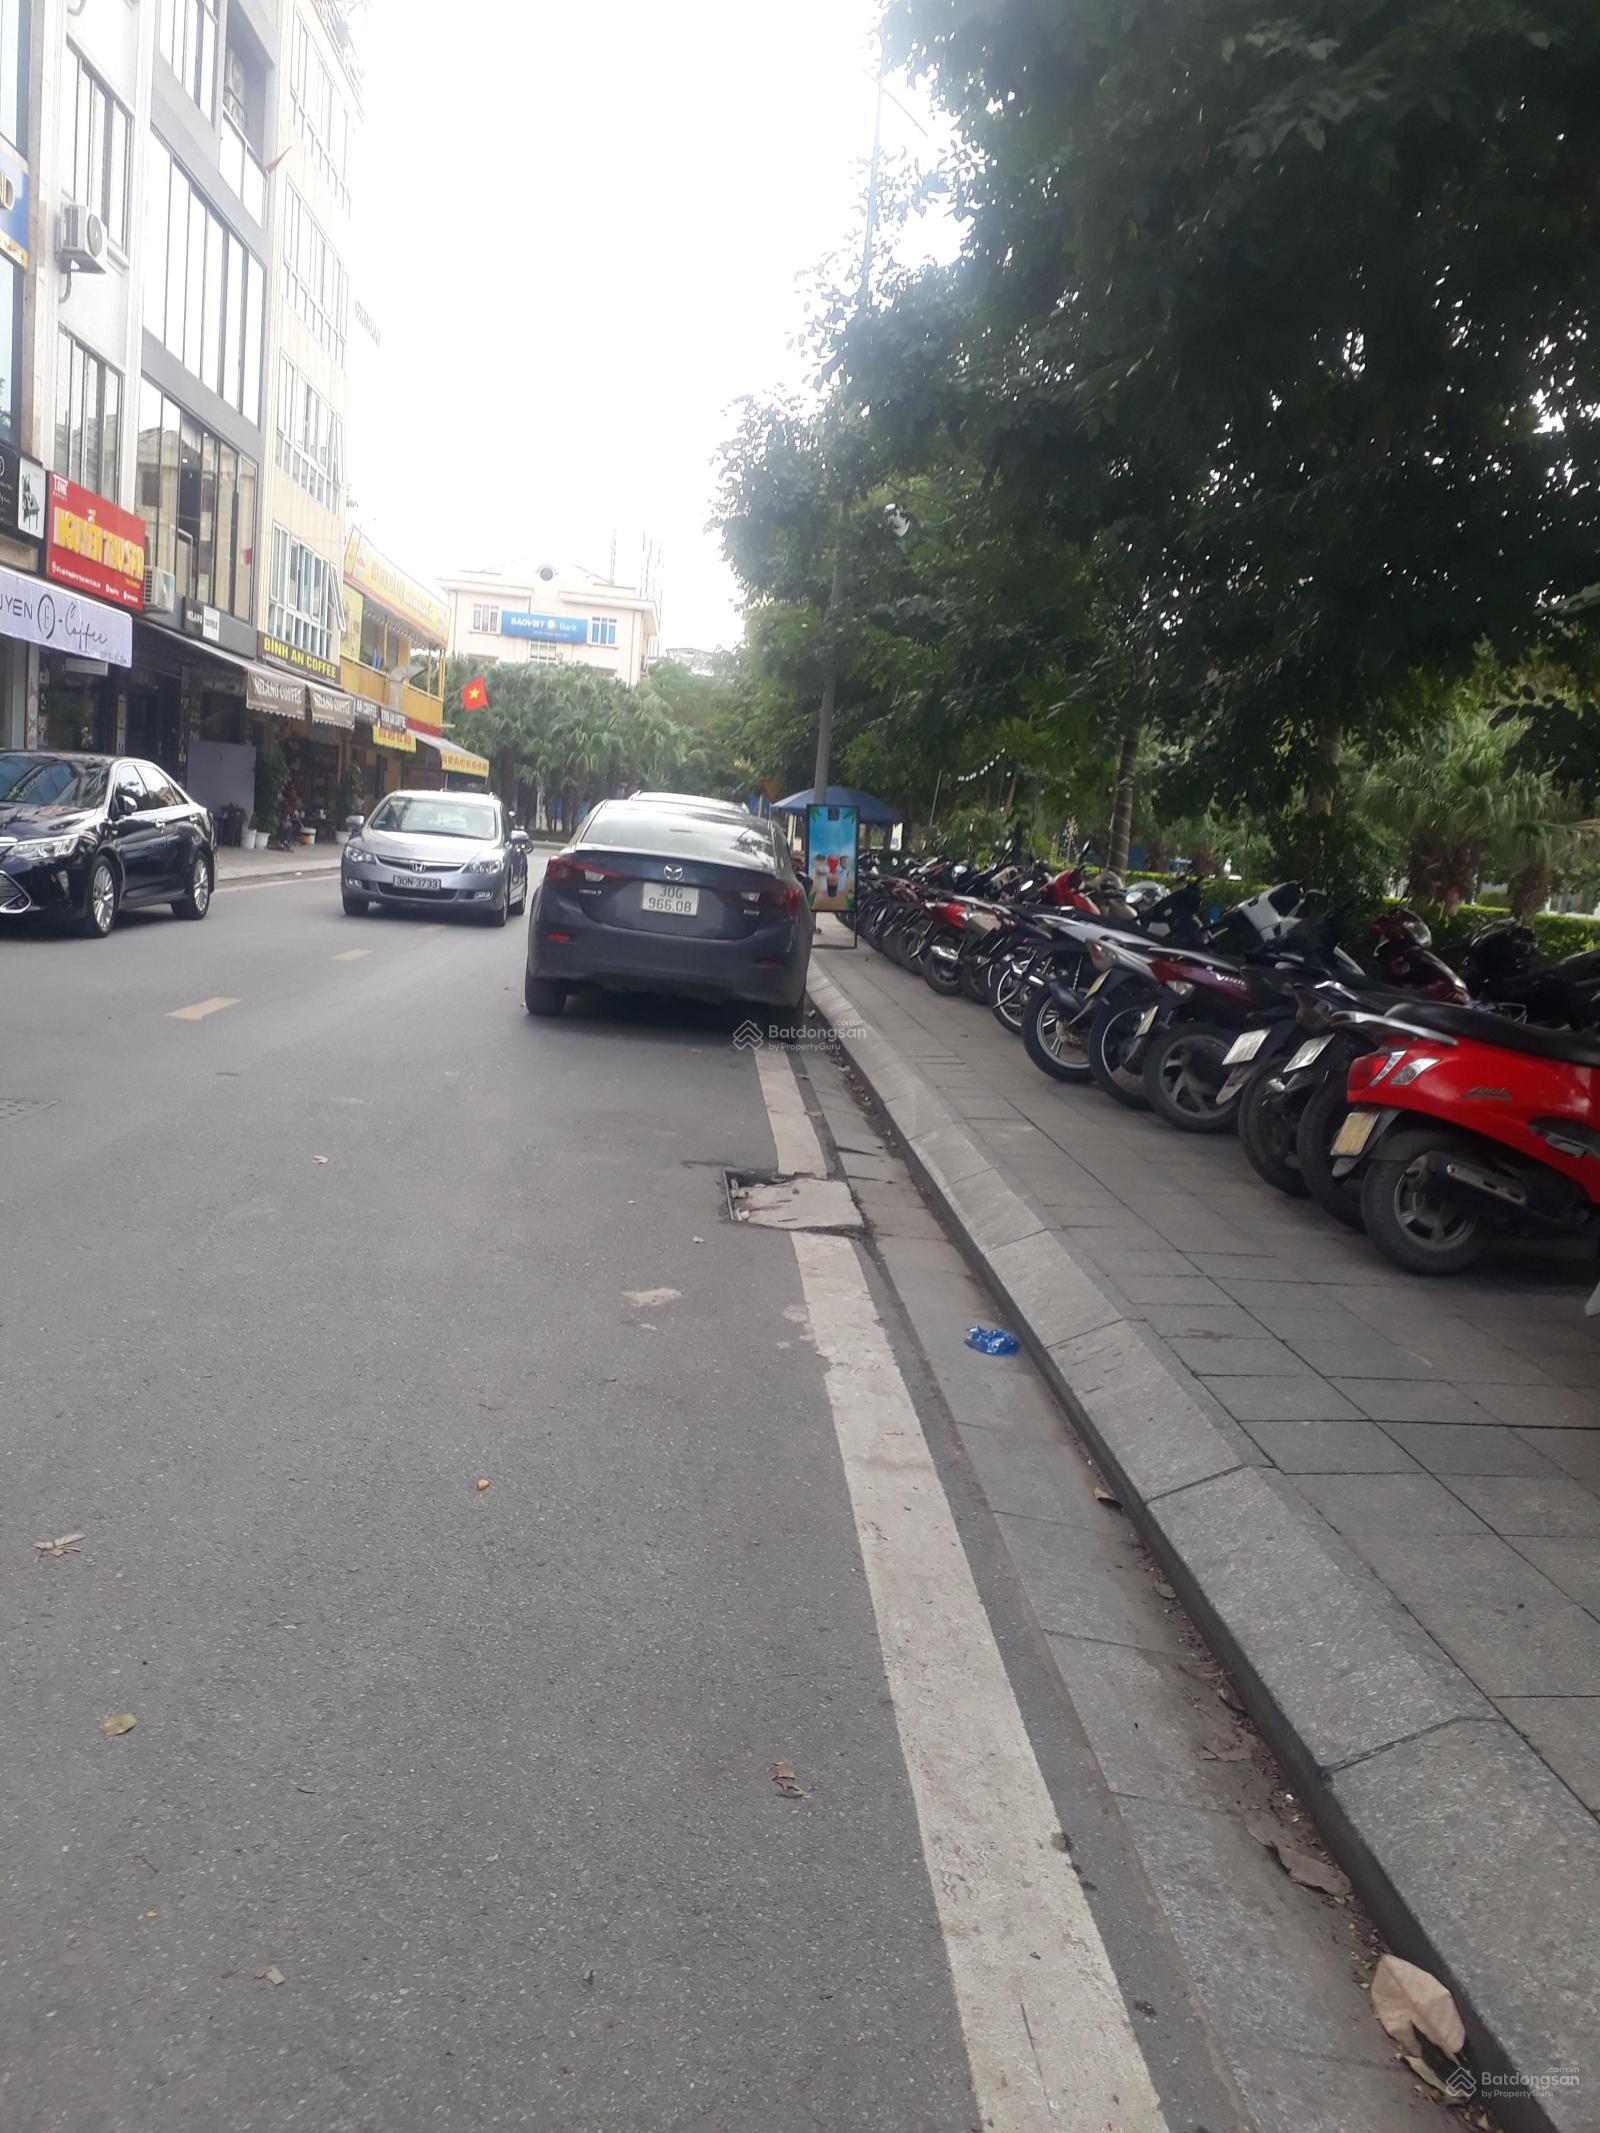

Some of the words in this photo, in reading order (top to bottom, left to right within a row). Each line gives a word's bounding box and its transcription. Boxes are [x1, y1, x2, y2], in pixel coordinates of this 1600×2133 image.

[291, 649, 305, 667] AN
[306, 655, 337, 679] COFFEE
[660, 885, 683, 899] 30G
